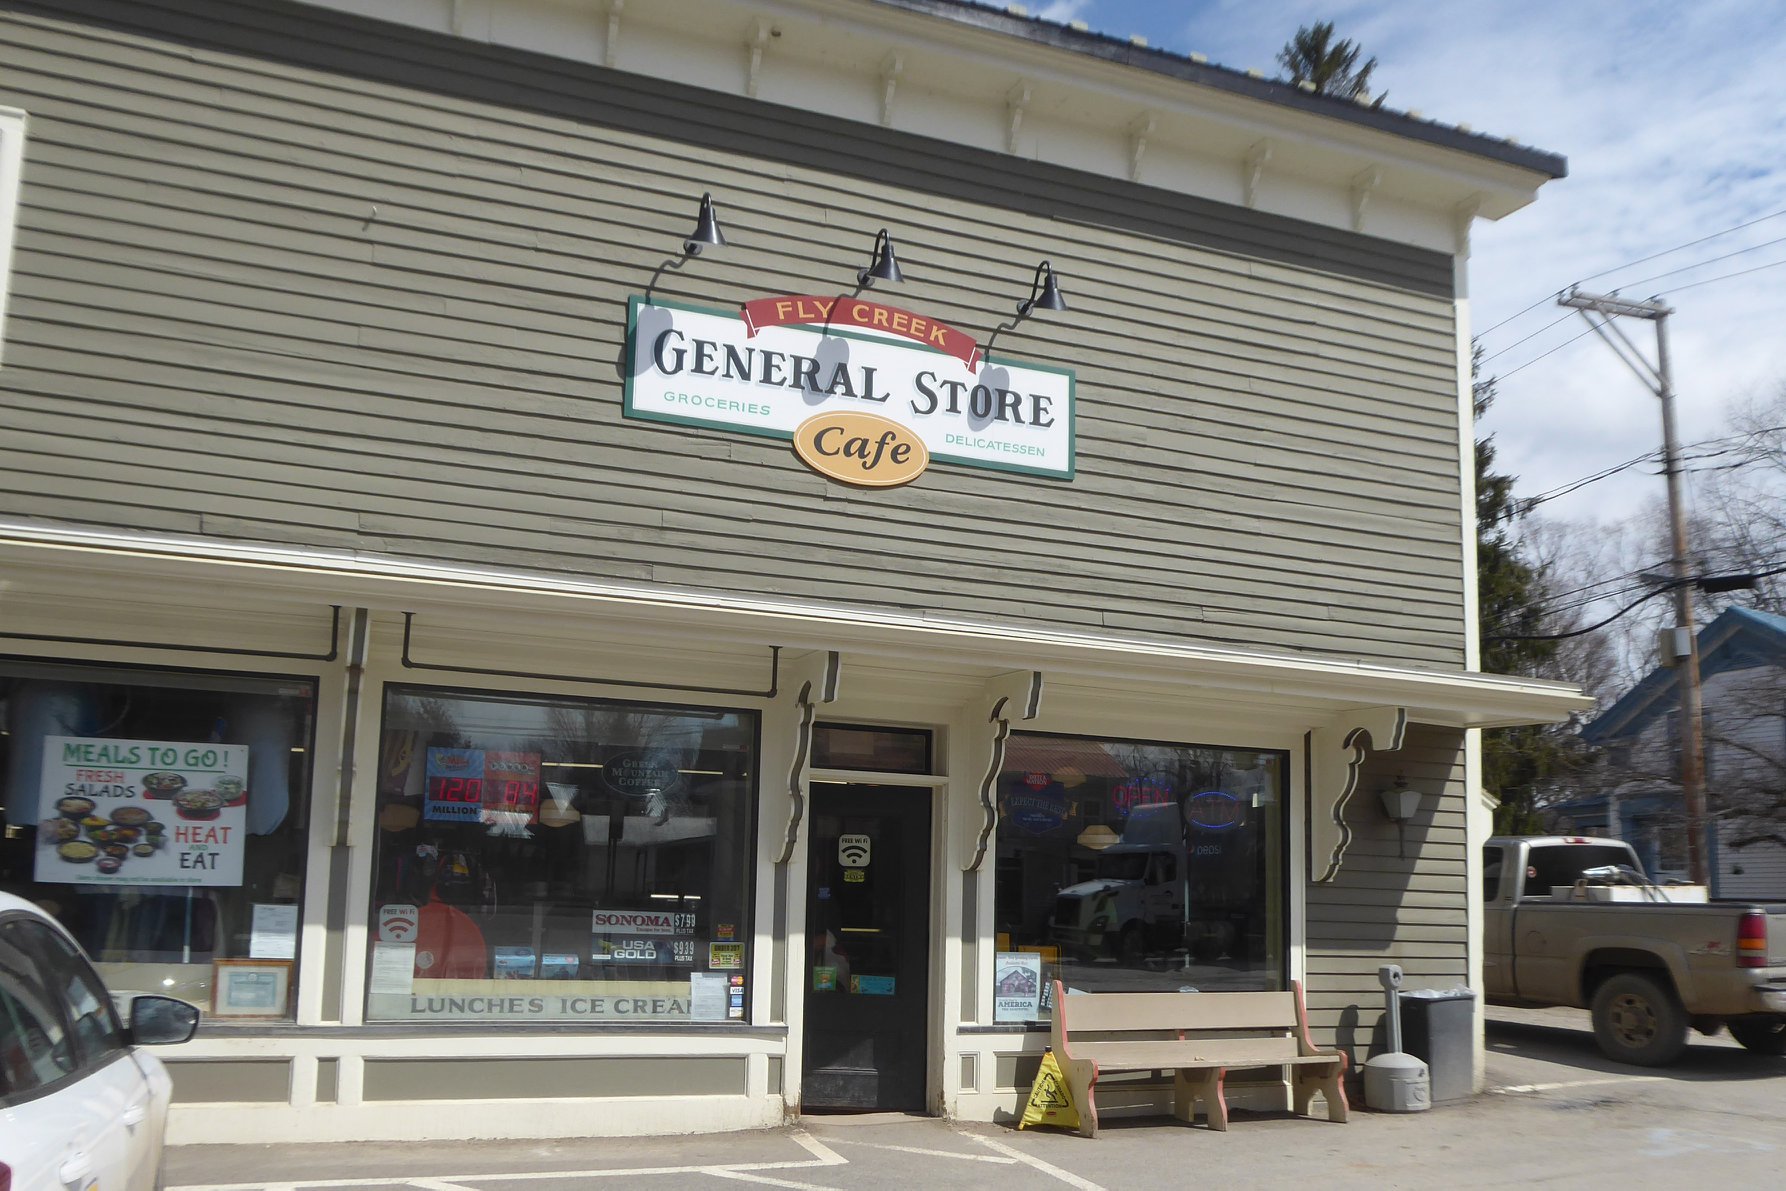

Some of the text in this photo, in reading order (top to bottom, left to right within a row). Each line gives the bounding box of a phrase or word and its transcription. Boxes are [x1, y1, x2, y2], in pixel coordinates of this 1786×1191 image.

[775, 300, 948, 346] FLY CREEK
[653, 328, 1056, 429] GENERAL STORE
[663, 390, 772, 416] GROCERIES
[813, 425, 912, 471] Cafe
[945, 433, 1046, 457] DELICATESSEN
[63, 743, 140, 764] MEALS
[147, 747, 178, 766] TO
[76, 769, 125, 784] FRESH
[64, 783, 136, 798] SALADS
[440, 778, 481, 802] 120
[1111, 784, 1169, 810] OPEN
[432, 805, 477, 814] MILLION
[1191, 800, 1240, 820] ATM
[175, 826, 232, 844] HEAT
[180, 852, 220, 870] EAT
[595, 914, 672, 927] SONOMA
[614, 949, 656, 959] GOLD
[622, 940, 655, 950] USA
[410, 998, 544, 1015] LUNCHES
[560, 998, 605, 1015] ICE
